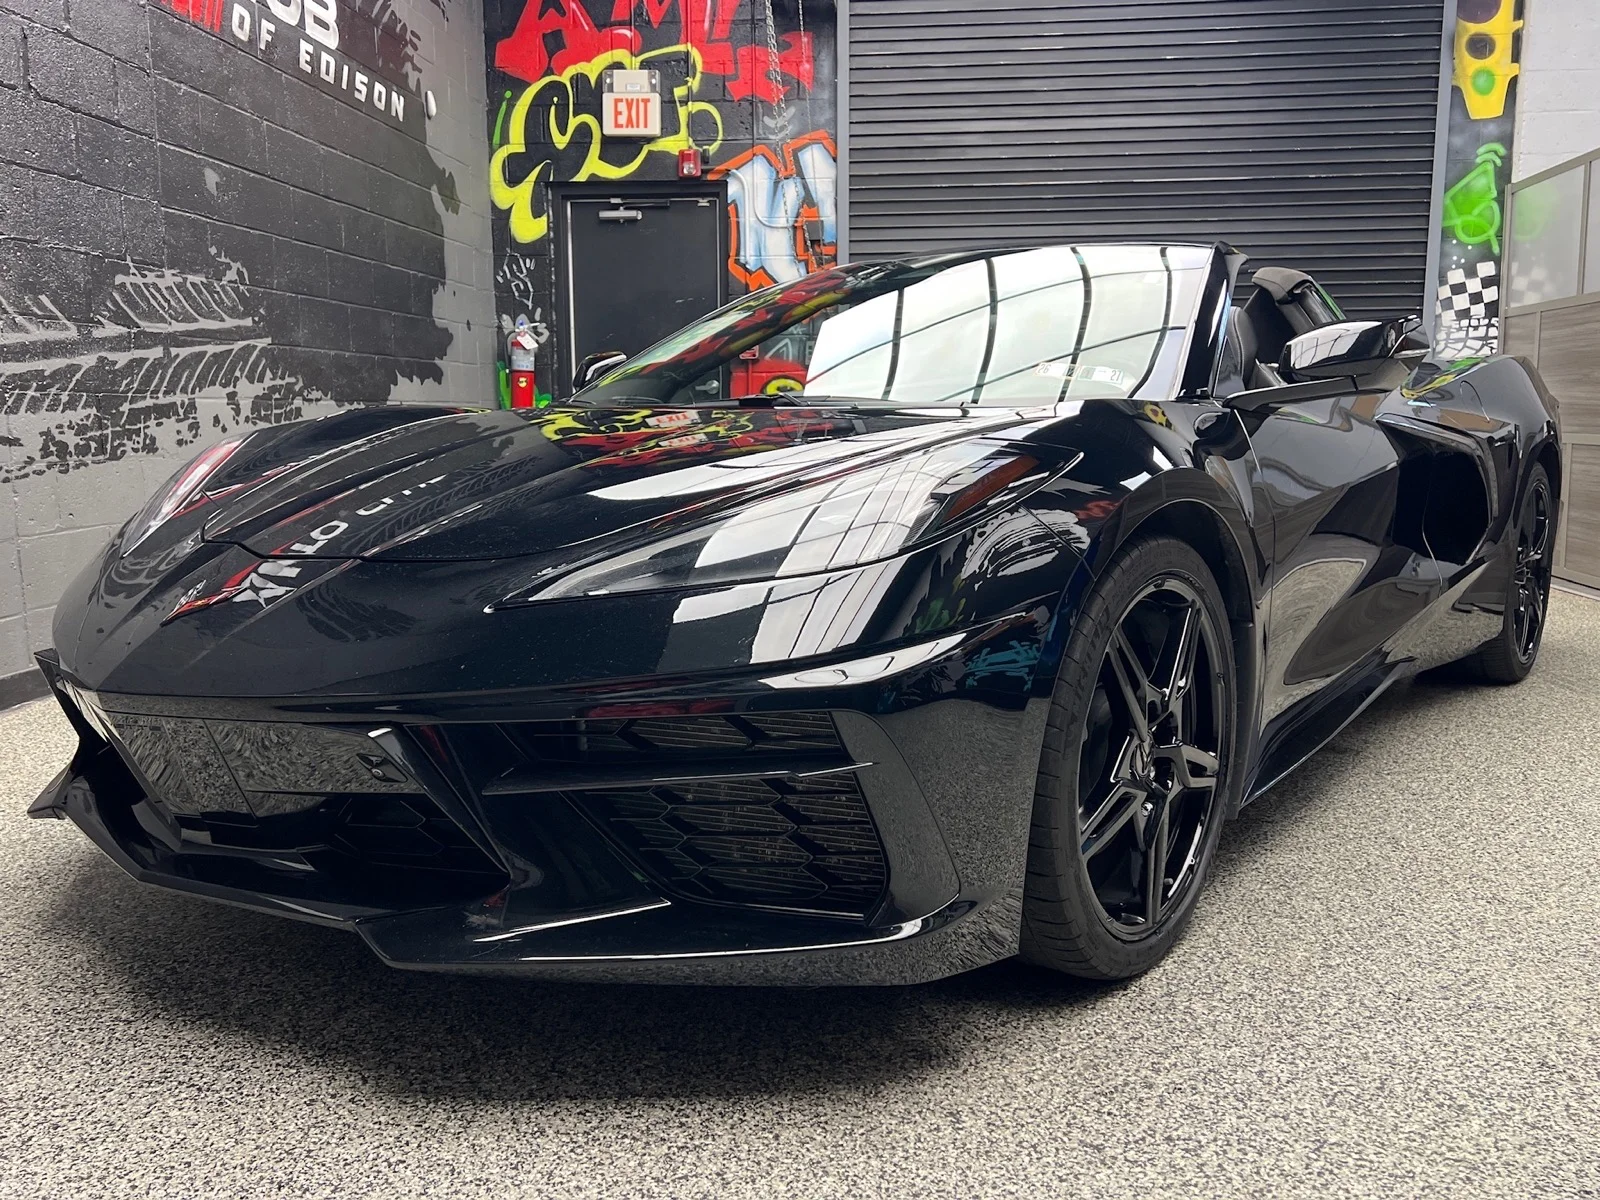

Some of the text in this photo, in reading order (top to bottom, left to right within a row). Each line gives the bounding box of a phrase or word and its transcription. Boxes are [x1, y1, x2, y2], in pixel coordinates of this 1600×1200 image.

[231, 2, 404, 122] OF EDISON
[613, 97, 651, 129] EXIT
